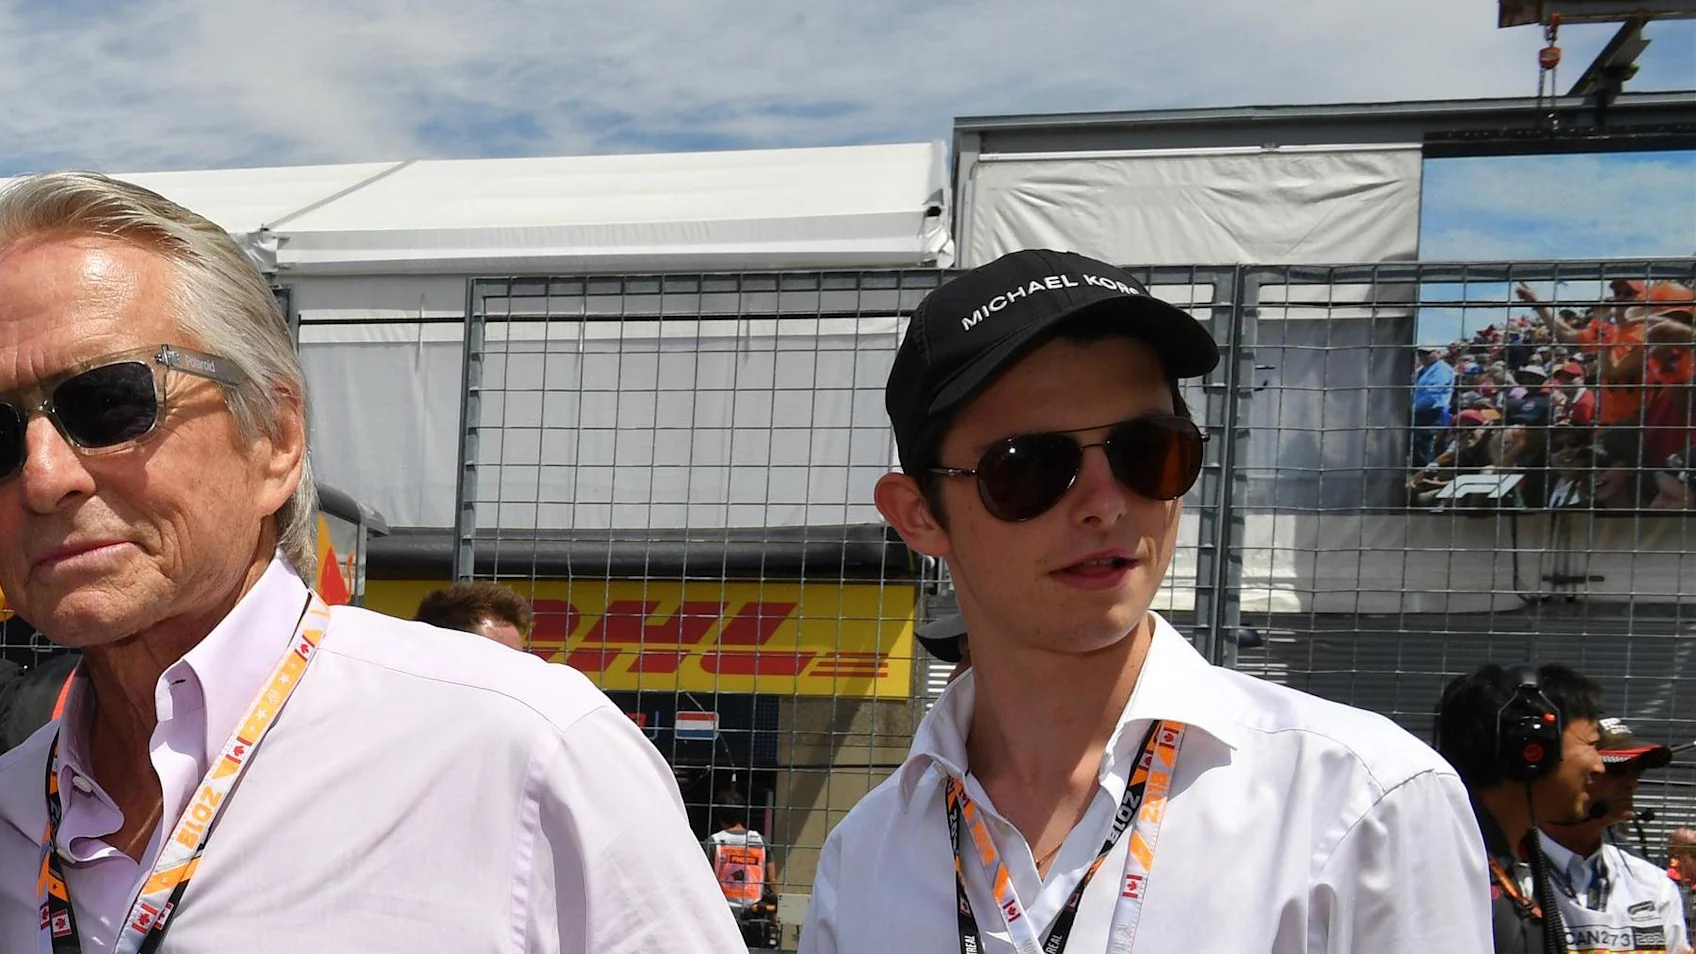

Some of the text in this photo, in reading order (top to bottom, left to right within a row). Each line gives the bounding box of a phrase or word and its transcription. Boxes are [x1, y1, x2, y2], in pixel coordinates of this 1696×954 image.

[961, 274, 1079, 332] MICHAEL
[175, 786, 224, 851] 2018
[1109, 789, 1142, 845] 2018
